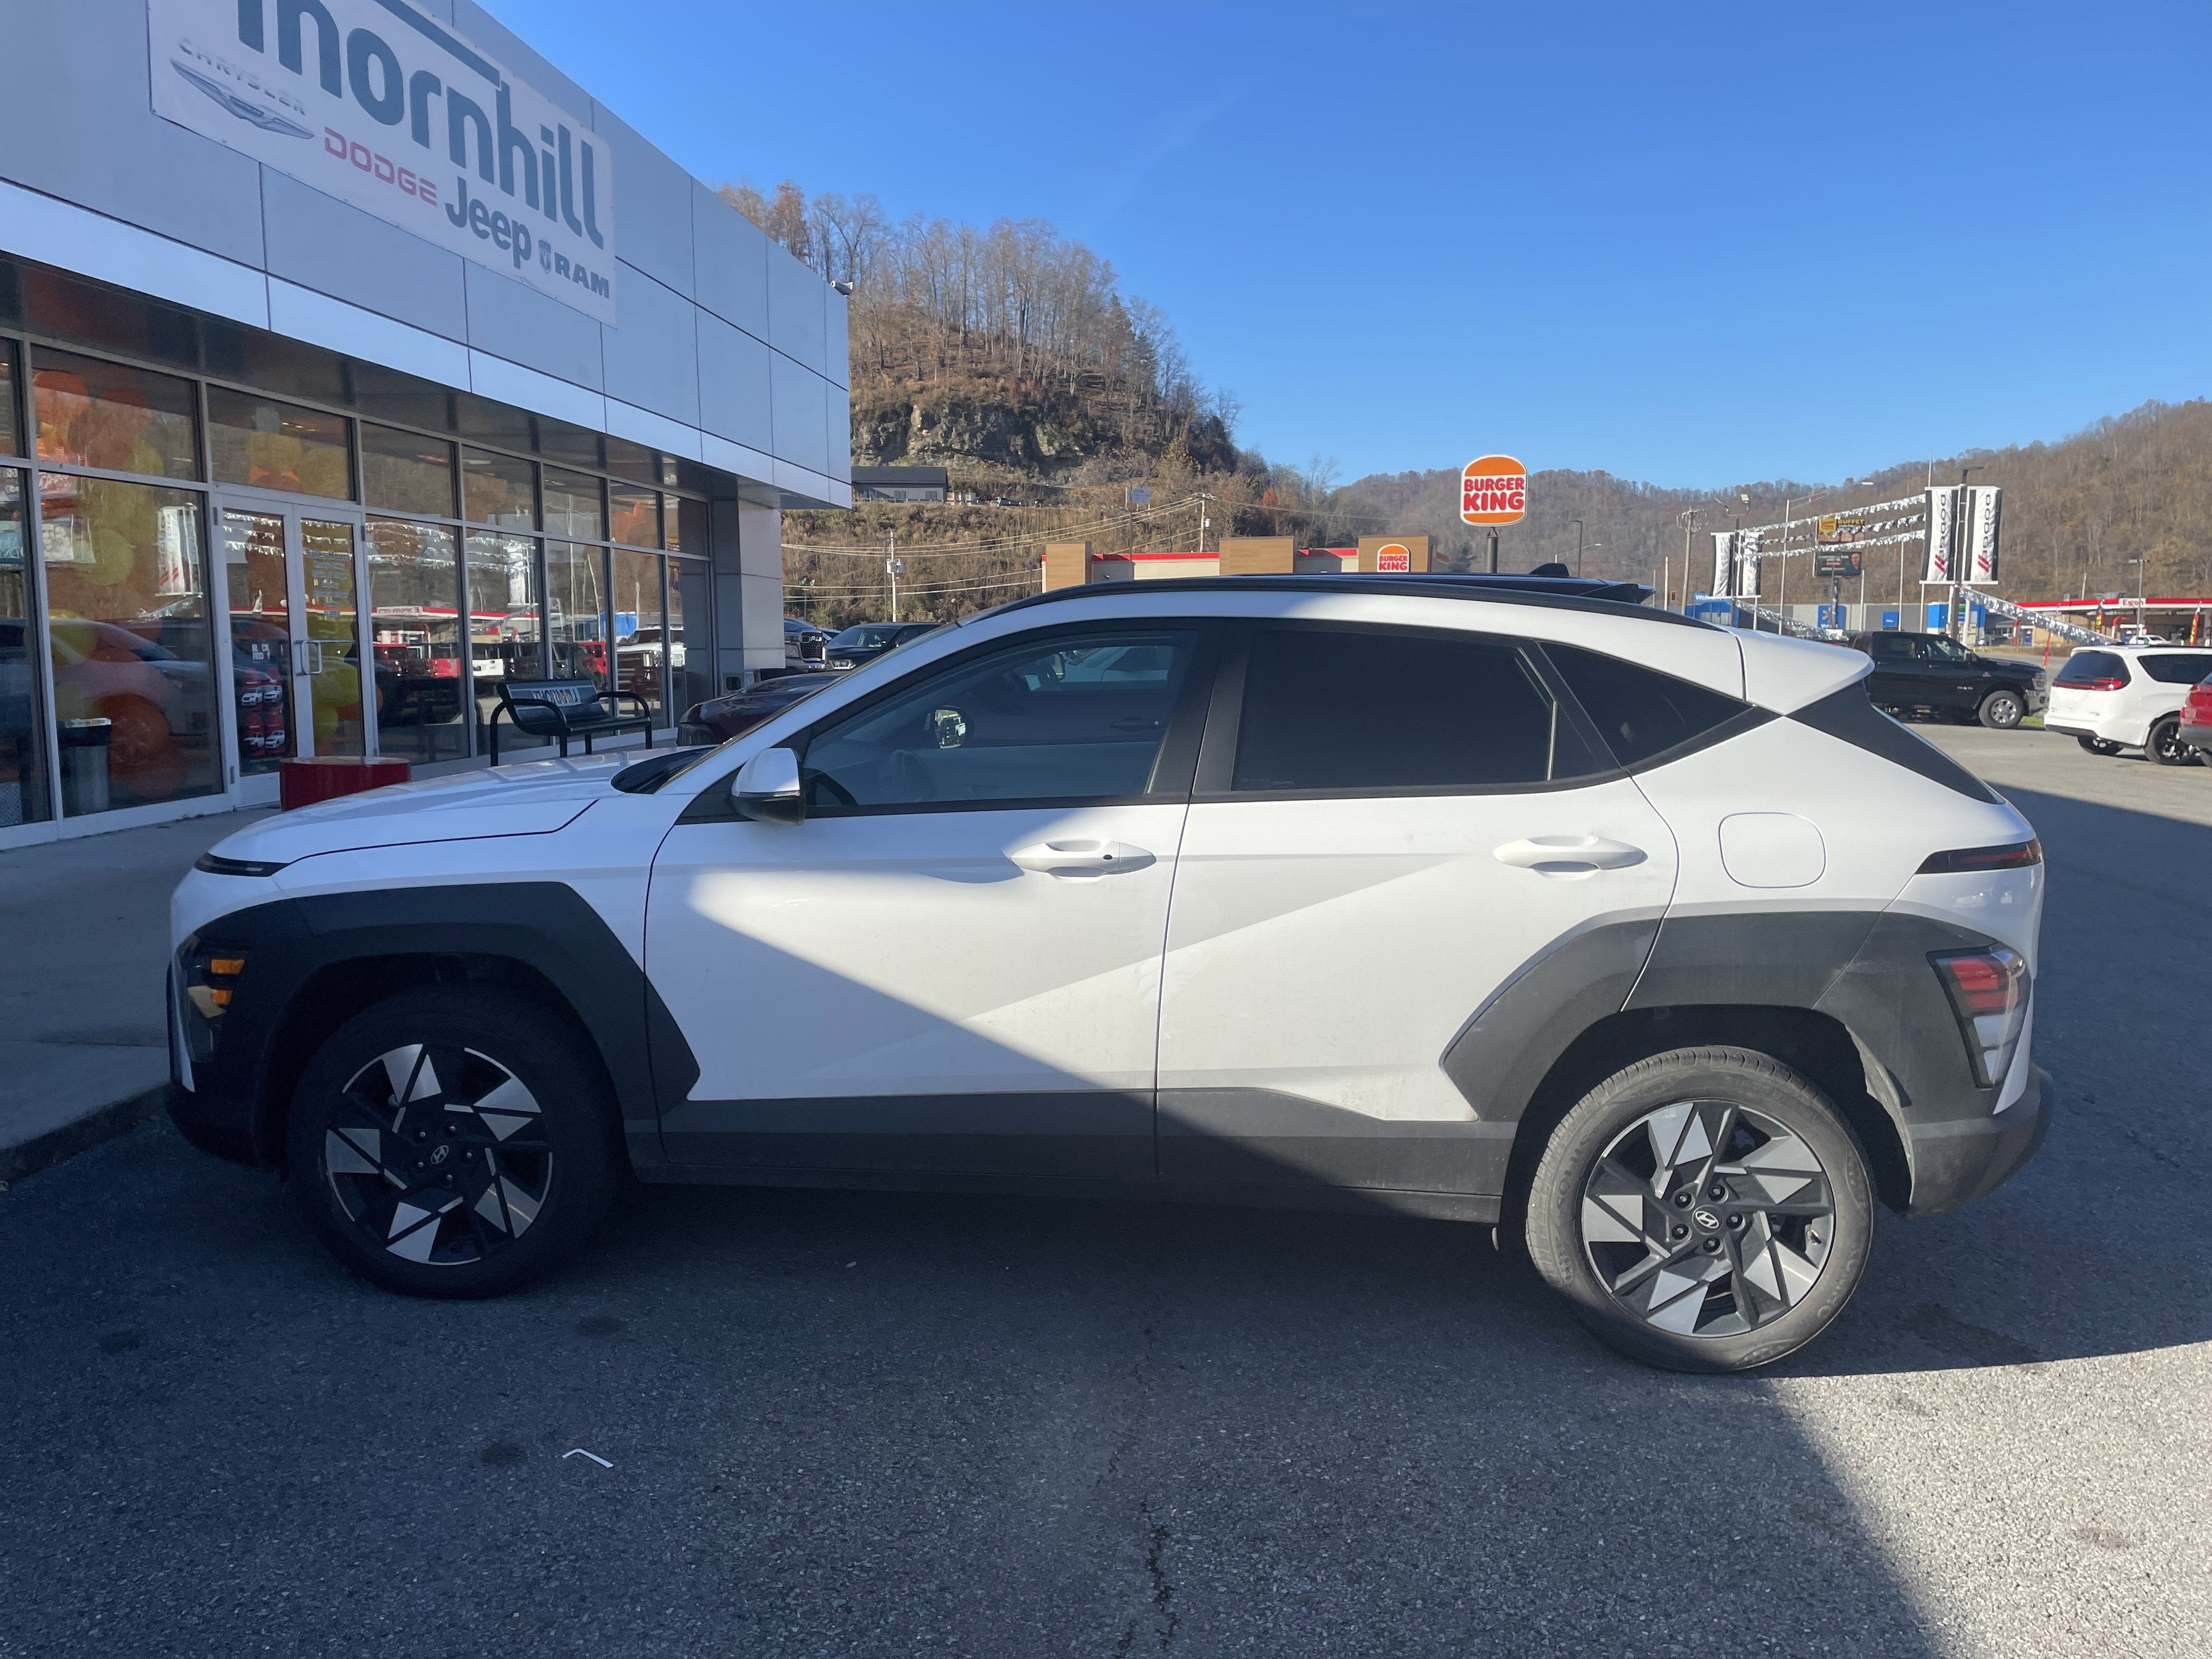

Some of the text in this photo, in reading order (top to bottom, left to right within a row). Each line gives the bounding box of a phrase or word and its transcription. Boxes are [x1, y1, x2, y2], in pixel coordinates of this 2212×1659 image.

[179, 37, 306, 115] CHRYSLER
[324, 126, 438, 207] DODGE
[445, 176, 532, 269] Jeep
[554, 252, 610, 300] RAM
[1464, 477, 1525, 492] BURGER
[1464, 491, 1525, 511] KING
[1983, 494, 1991, 562] DODGE
[1379, 562, 1408, 571] KING
